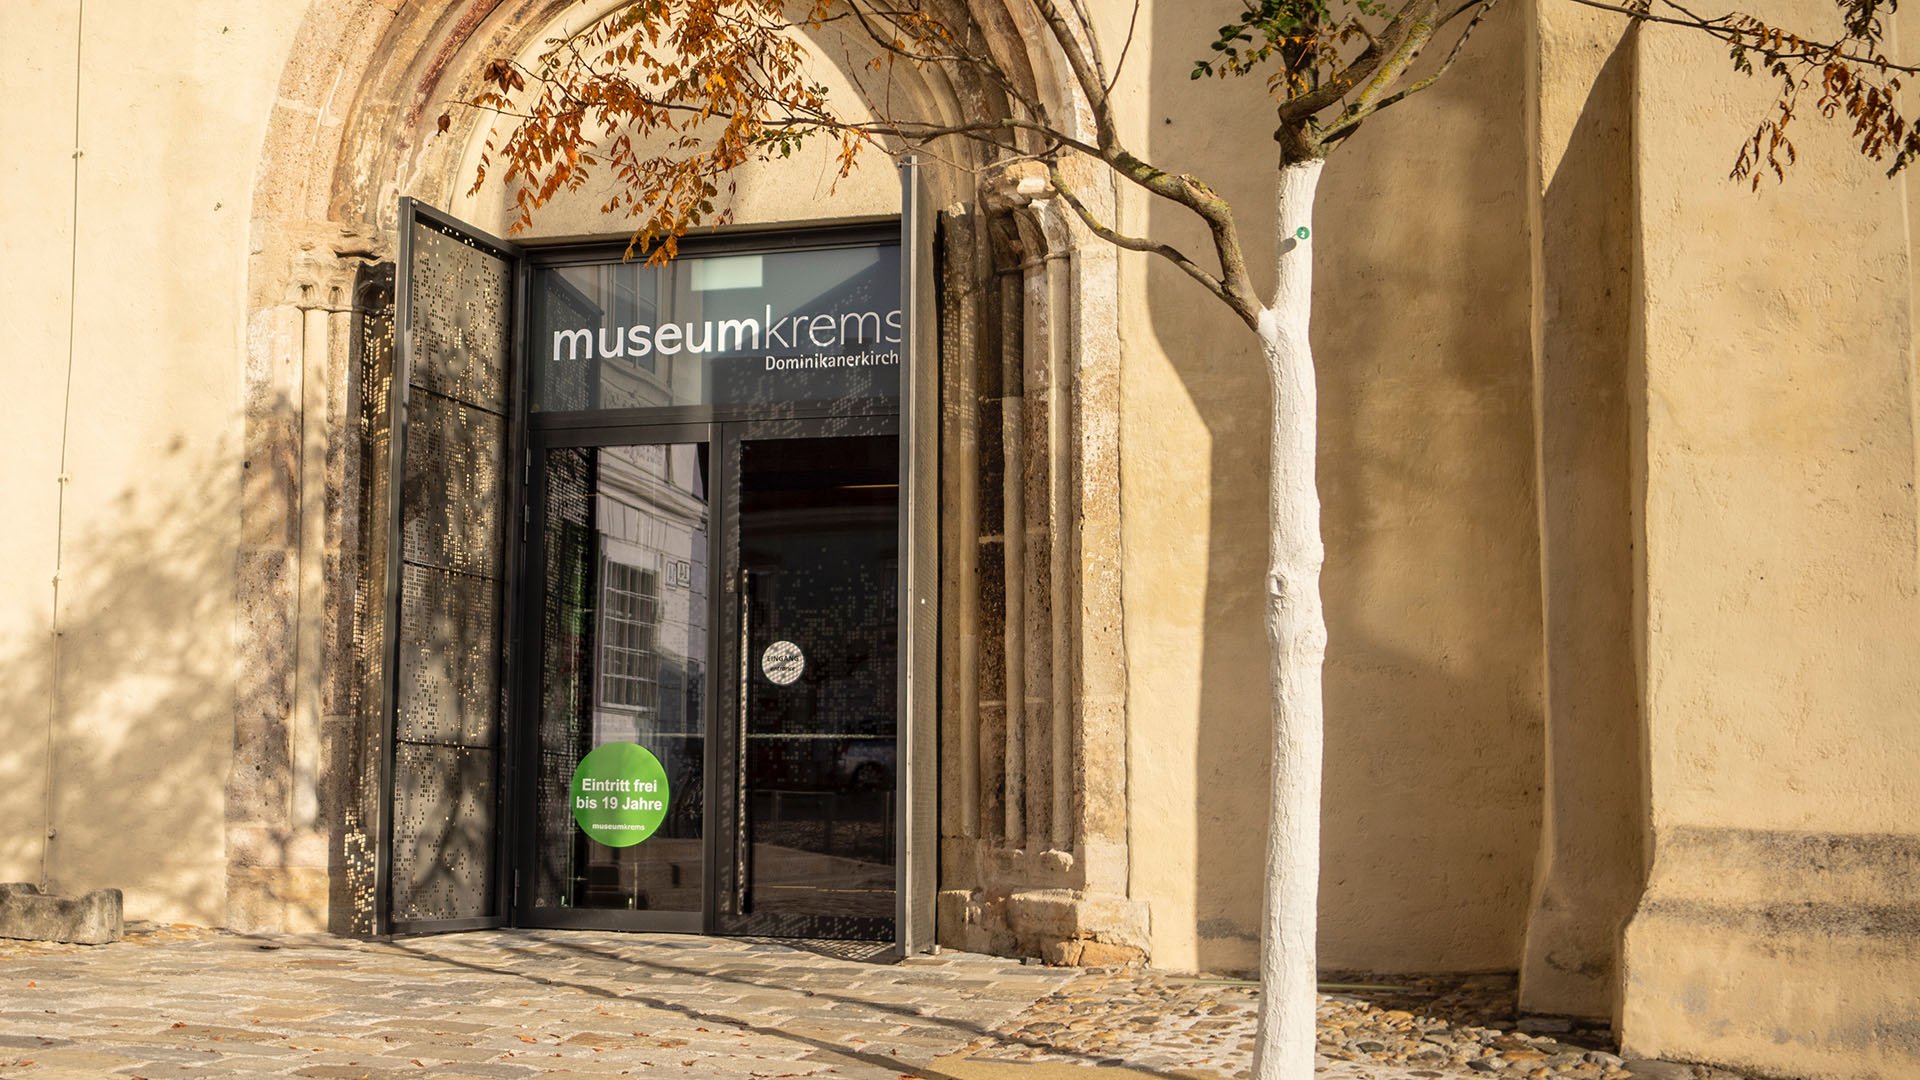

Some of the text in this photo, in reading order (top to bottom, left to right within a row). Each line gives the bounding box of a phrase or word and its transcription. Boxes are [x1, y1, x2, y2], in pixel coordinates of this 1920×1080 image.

[765, 350, 901, 371] Dominikanerkirch
[582, 778, 657, 792] Eintritt frei
[576, 796, 662, 811] bis 19 Jahre
[592, 823, 645, 831] museumkrems
